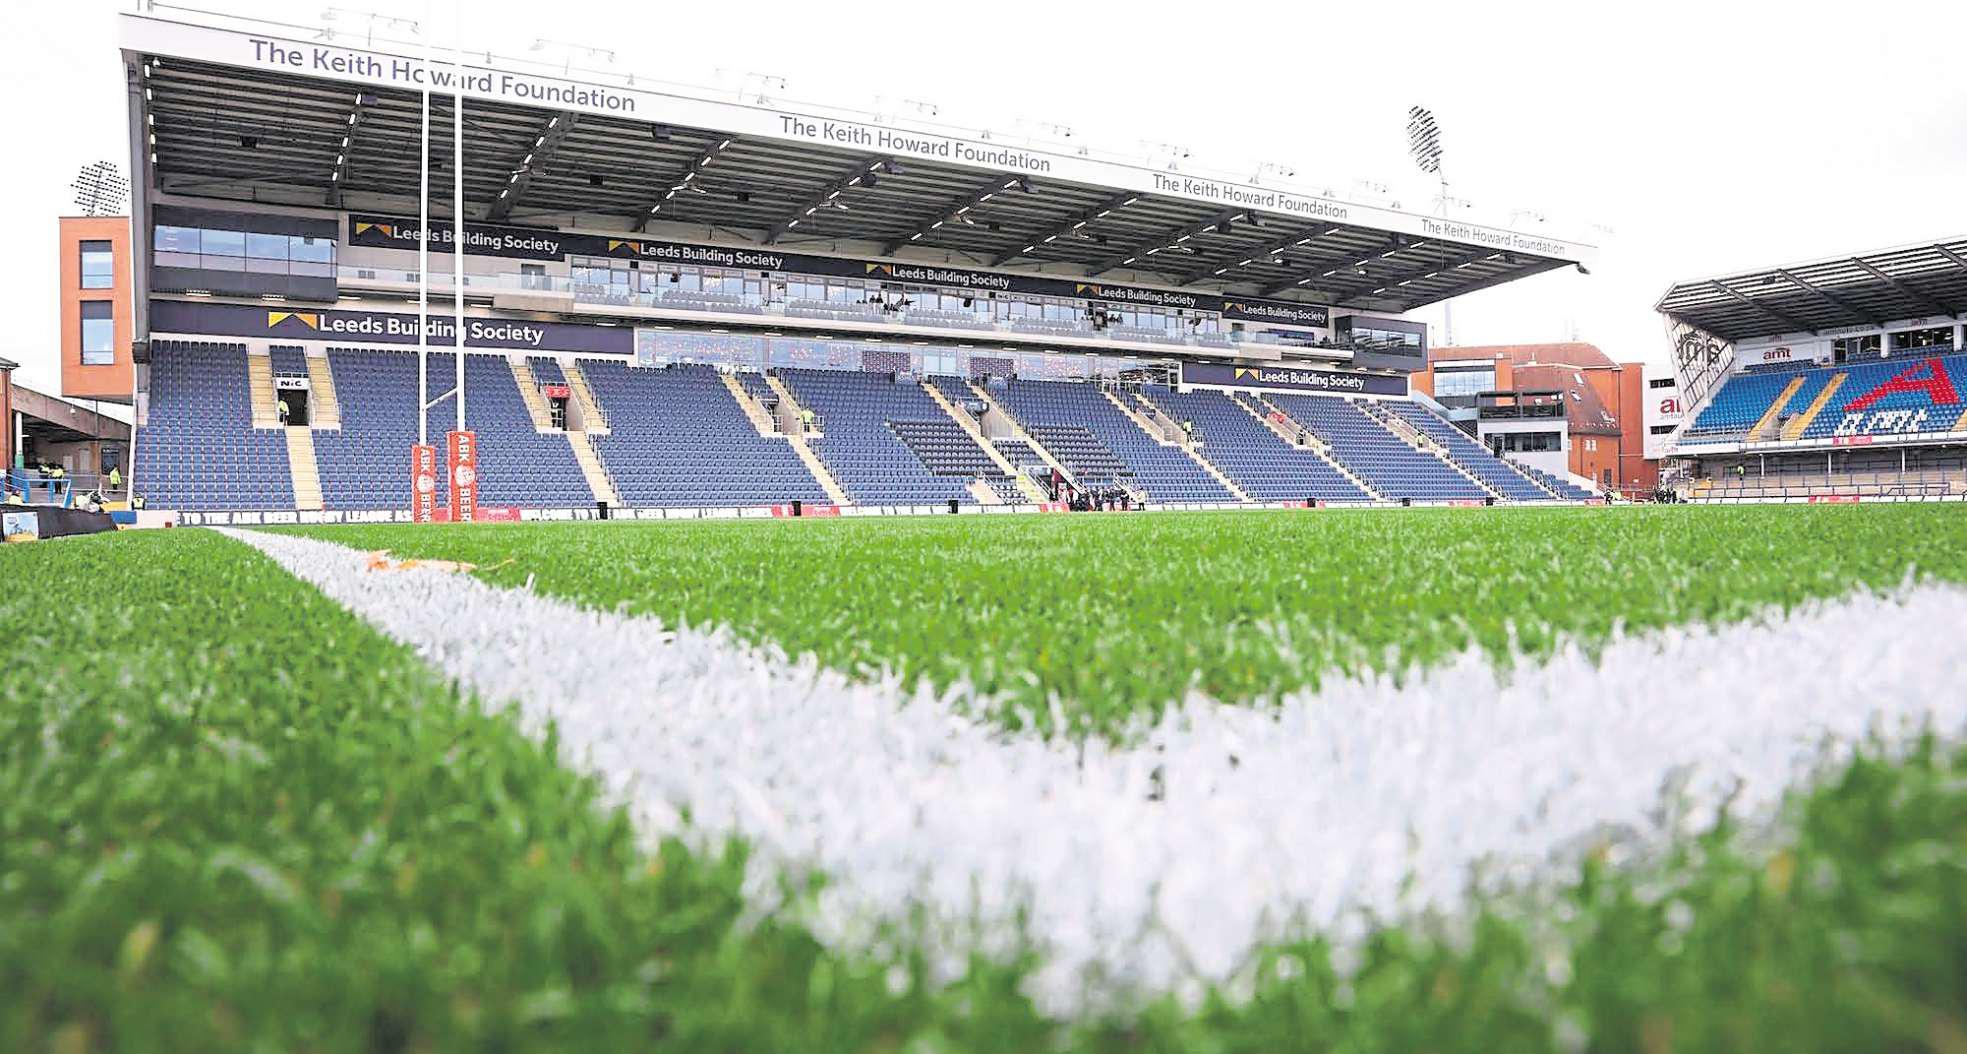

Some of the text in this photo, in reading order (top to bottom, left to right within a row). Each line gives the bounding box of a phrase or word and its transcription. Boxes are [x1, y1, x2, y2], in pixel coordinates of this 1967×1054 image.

[250, 40, 303, 66] The
[313, 48, 382, 78] Keith
[501, 75, 635, 112] Foundation
[779, 115, 1050, 172] The Keith Howard Foundation
[1153, 174, 1348, 219] The Keith Howard Foundation
[442, 229, 501, 250] Bilding
[504, 235, 559, 254] Society
[1421, 218, 1566, 255] The Keith Howard Foundation
[640, 243, 783, 270] Leeds Building Society
[892, 265, 1010, 290] Leeds Building Society
[1098, 284, 1197, 309] Leeds Building Society
[1243, 303, 1326, 324] Leeds Building Society
[320, 314, 544, 345] Leeds Buidin Society
[1762, 346, 1792, 360] amt
[1259, 369, 1365, 390] Leeds Building Society
[420, 447, 431, 472] ABK
[458, 434, 470, 462] ABK
[460, 487, 472, 521] BEER
